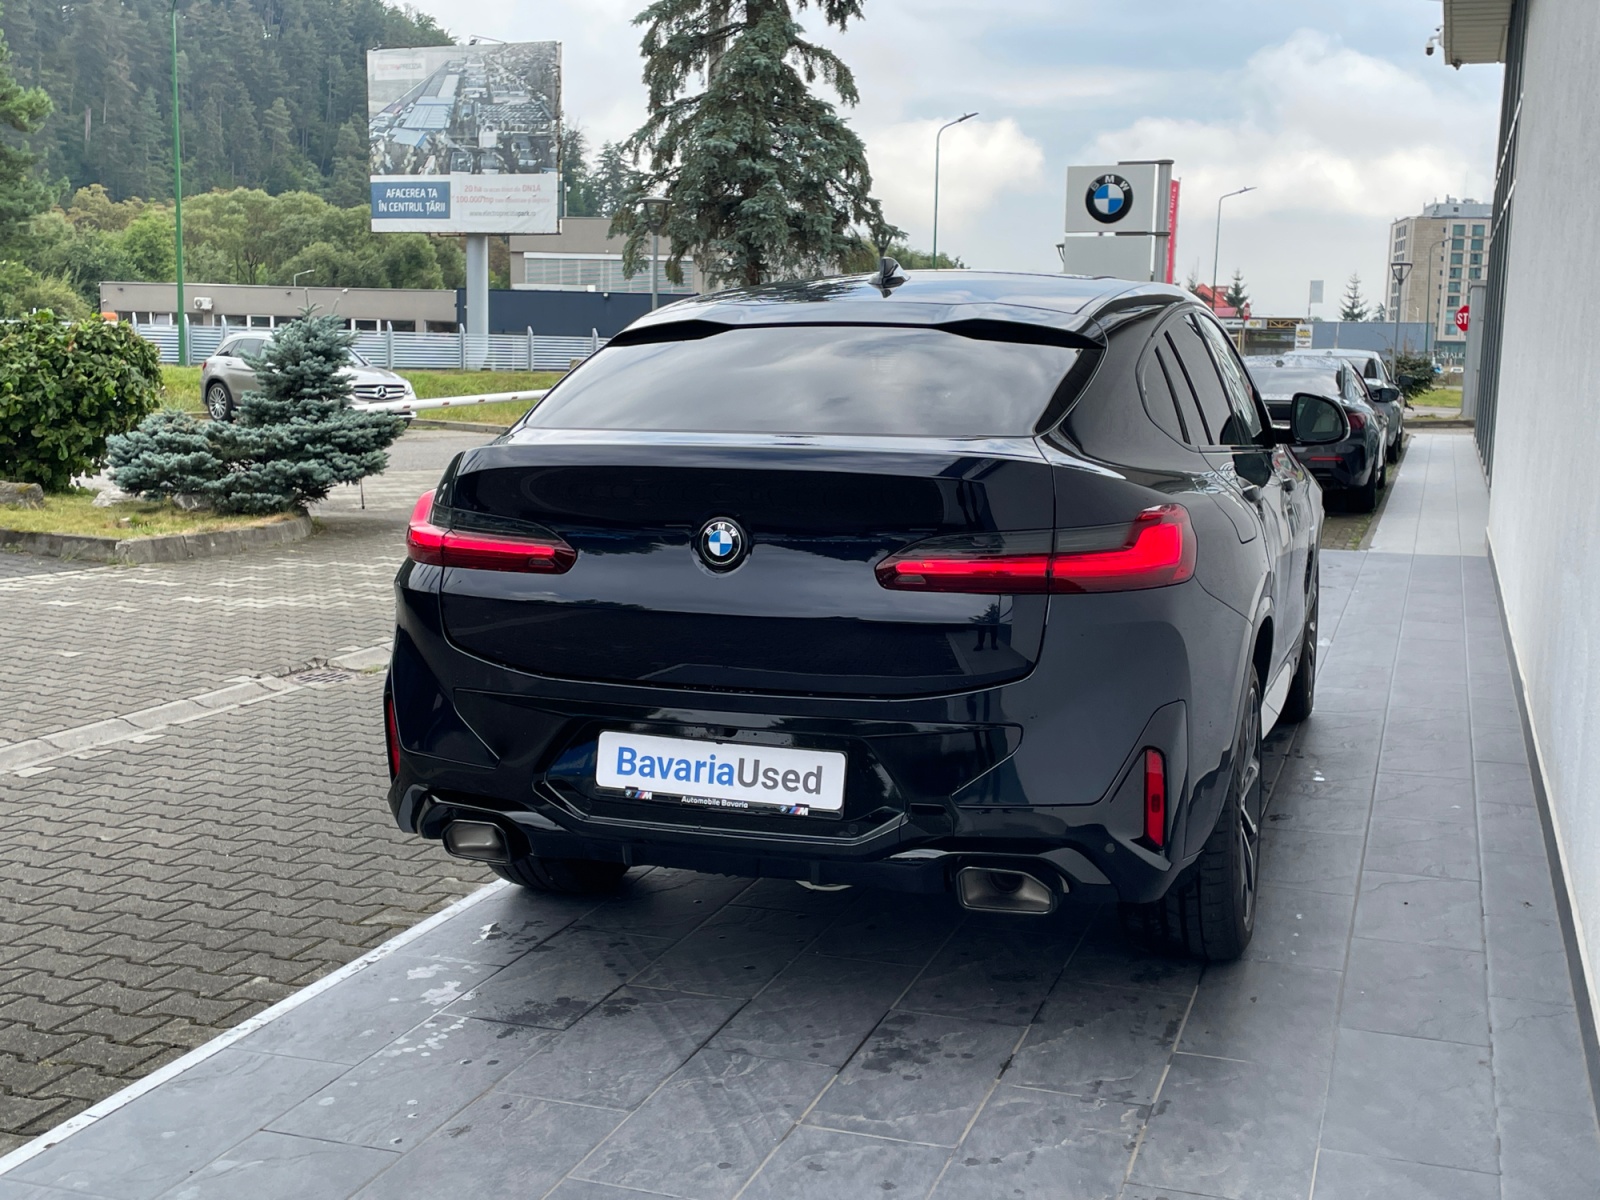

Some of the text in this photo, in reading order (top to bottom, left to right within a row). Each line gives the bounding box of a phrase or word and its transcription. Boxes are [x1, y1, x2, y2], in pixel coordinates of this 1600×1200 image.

[1090, 175, 1130, 191] BMW
[386, 188, 438, 198] AFACEREA TA
[378, 199, 387, 212] ÎN
[389, 202, 424, 212] CENTRUL
[1457, 313, 1469, 324] ST
[616, 746, 823, 795] BavariaUsed
[681, 795, 749, 809] Automobile Bavaria
